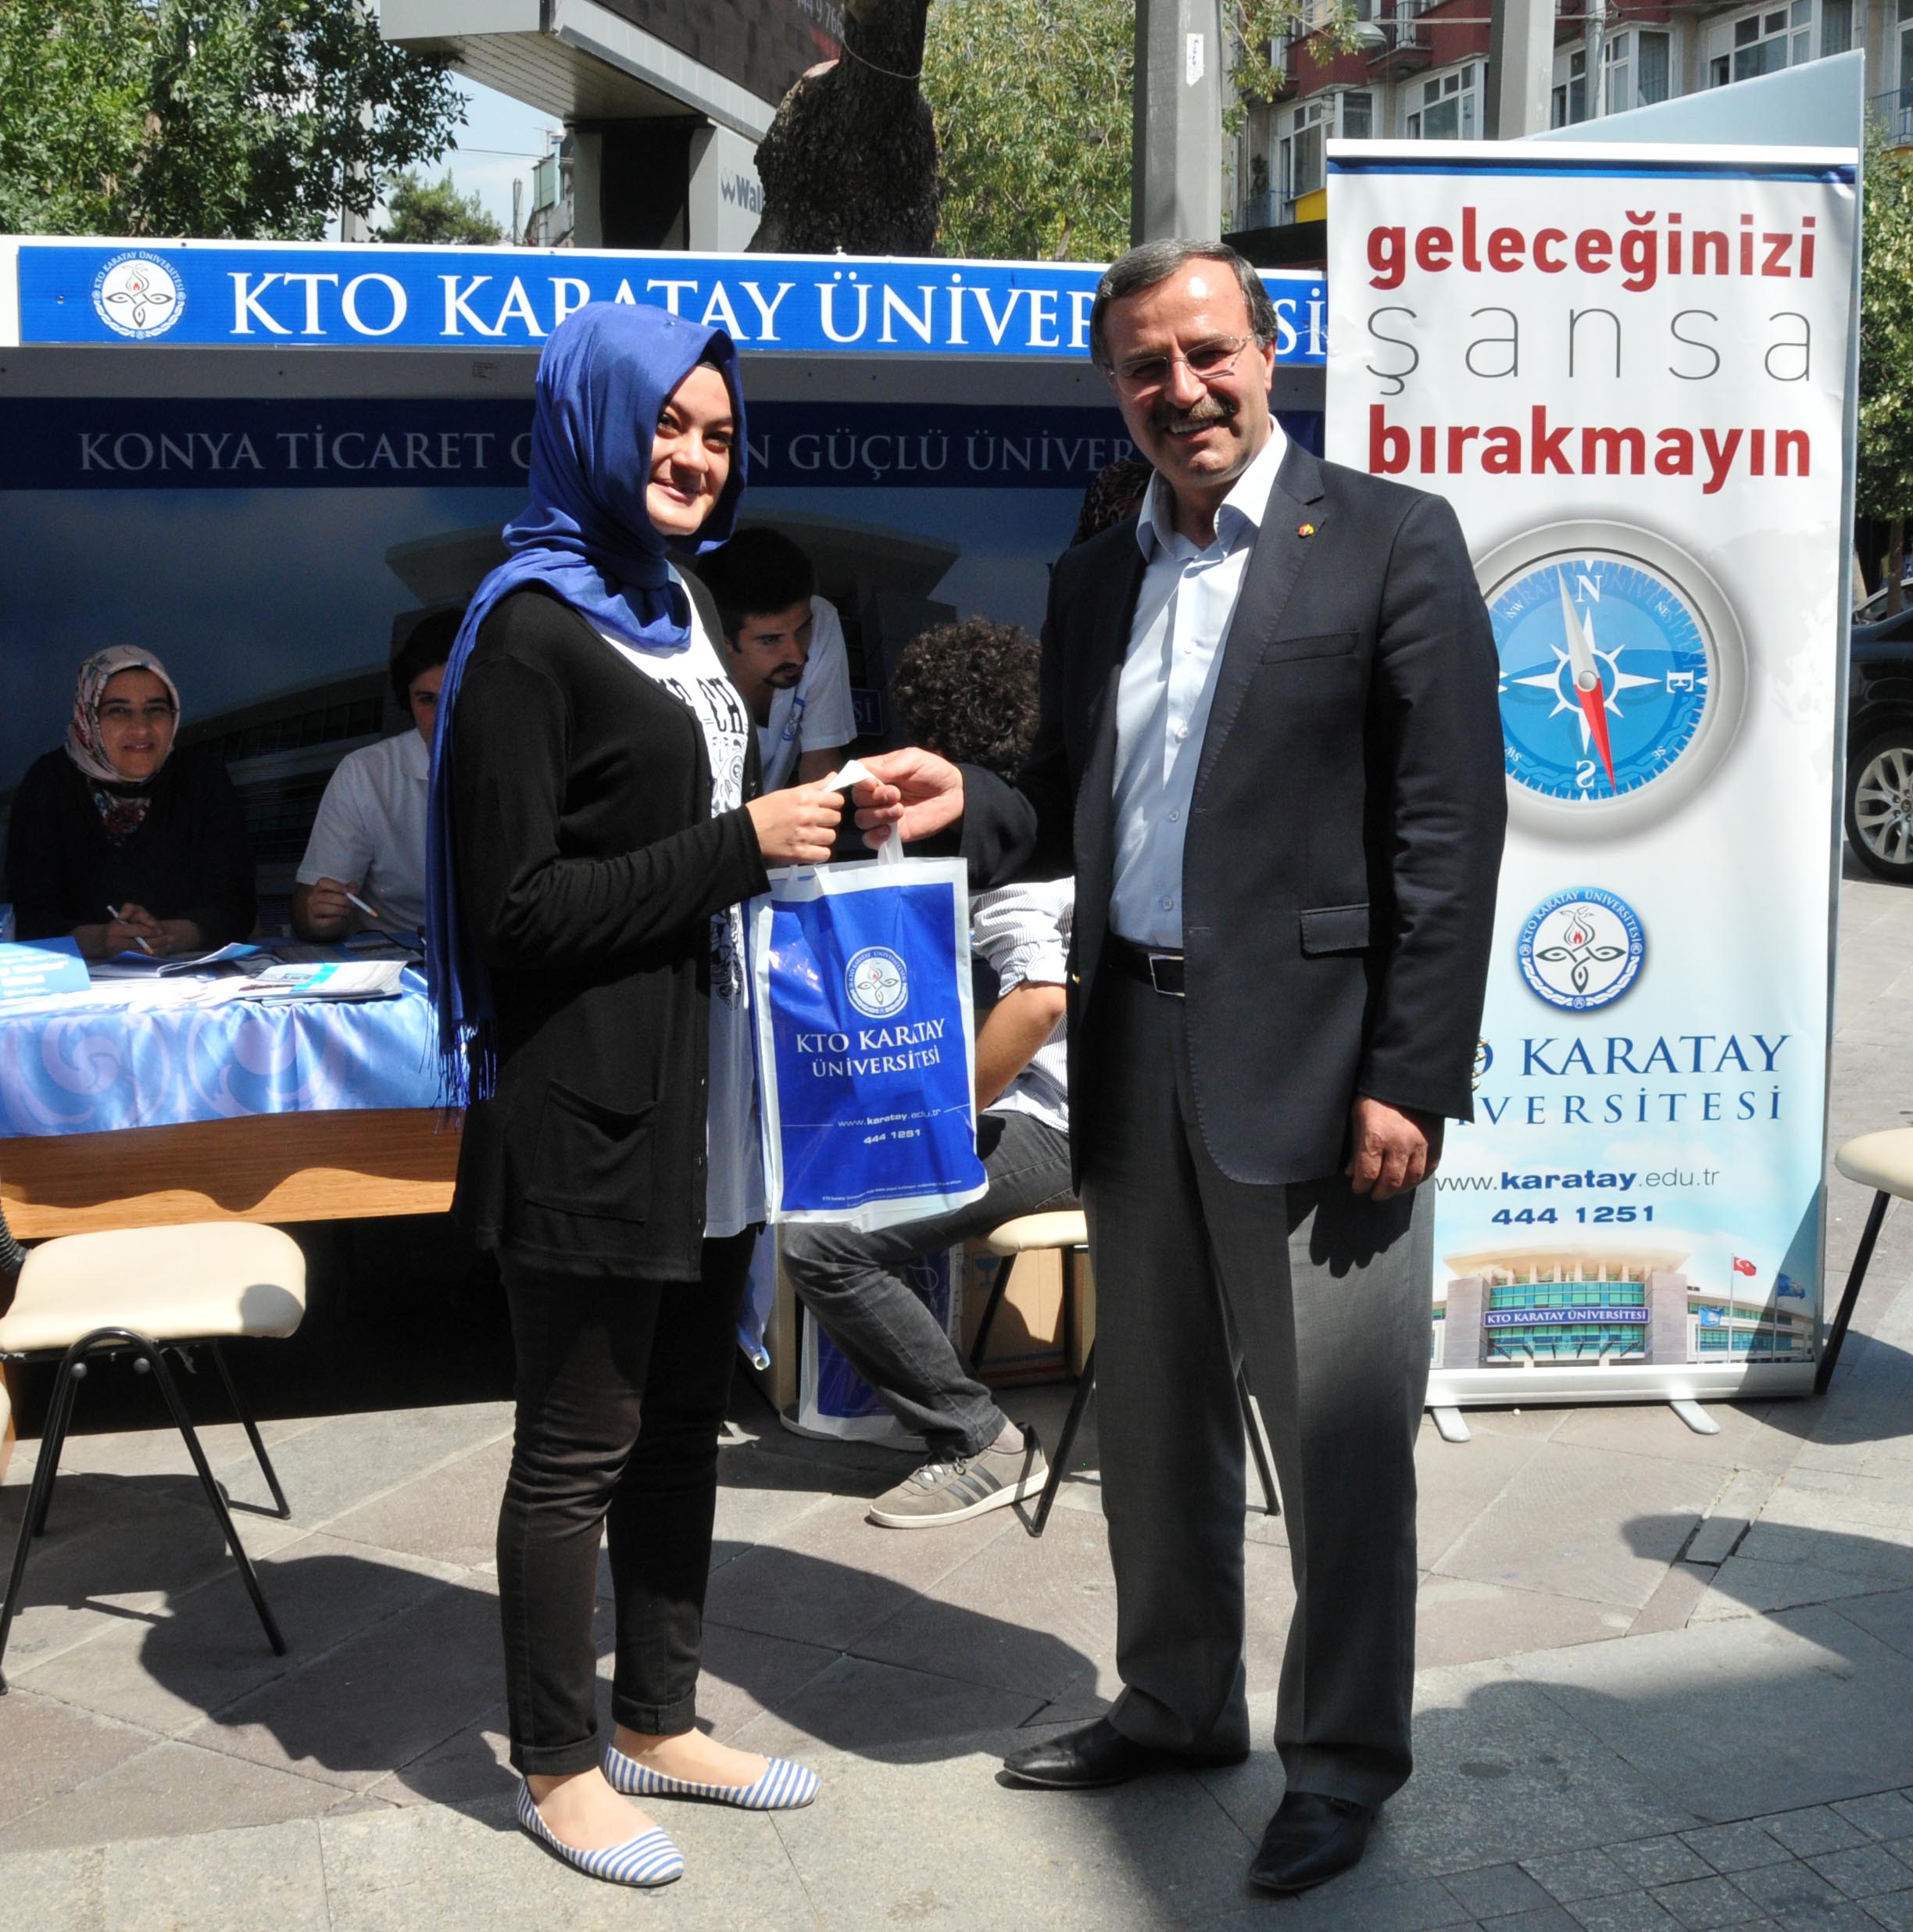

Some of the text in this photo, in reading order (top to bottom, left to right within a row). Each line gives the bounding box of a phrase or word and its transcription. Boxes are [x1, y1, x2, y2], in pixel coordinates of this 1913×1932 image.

[1366, 206, 1816, 292] geleceğinizi
[227, 272, 408, 336] KTO
[1365, 306, 1811, 395] şansa
[79, 431, 264, 470] KONYA
[276, 424, 495, 470] TİCARET
[788, 428, 948, 481] GÜÇLÜ
[967, 428, 1134, 472] ÜNİVER
[1369, 403, 1811, 495] bırakmayın
[1575, 574, 1604, 603] N
[1505, 599, 1524, 619] NW
[1654, 601, 1670, 618] NE
[1666, 669, 1694, 694] E
[1522, 920, 1538, 943] KTO
[1535, 891, 1580, 920] KARATAY
[796, 1018, 946, 1054] KTO KARATAY
[812, 1044, 941, 1077] ÜNİVERSİTESİ
[1519, 1033, 1793, 1076] KARATAY
[1456, 1084, 1782, 1126] VERSİTESİ
[863, 1133, 886, 1144] 444
[1491, 1205, 1655, 1225] 444 1251
[1487, 1309, 1647, 1324] KTO KARATAY ÜNİVERSİTESİ
